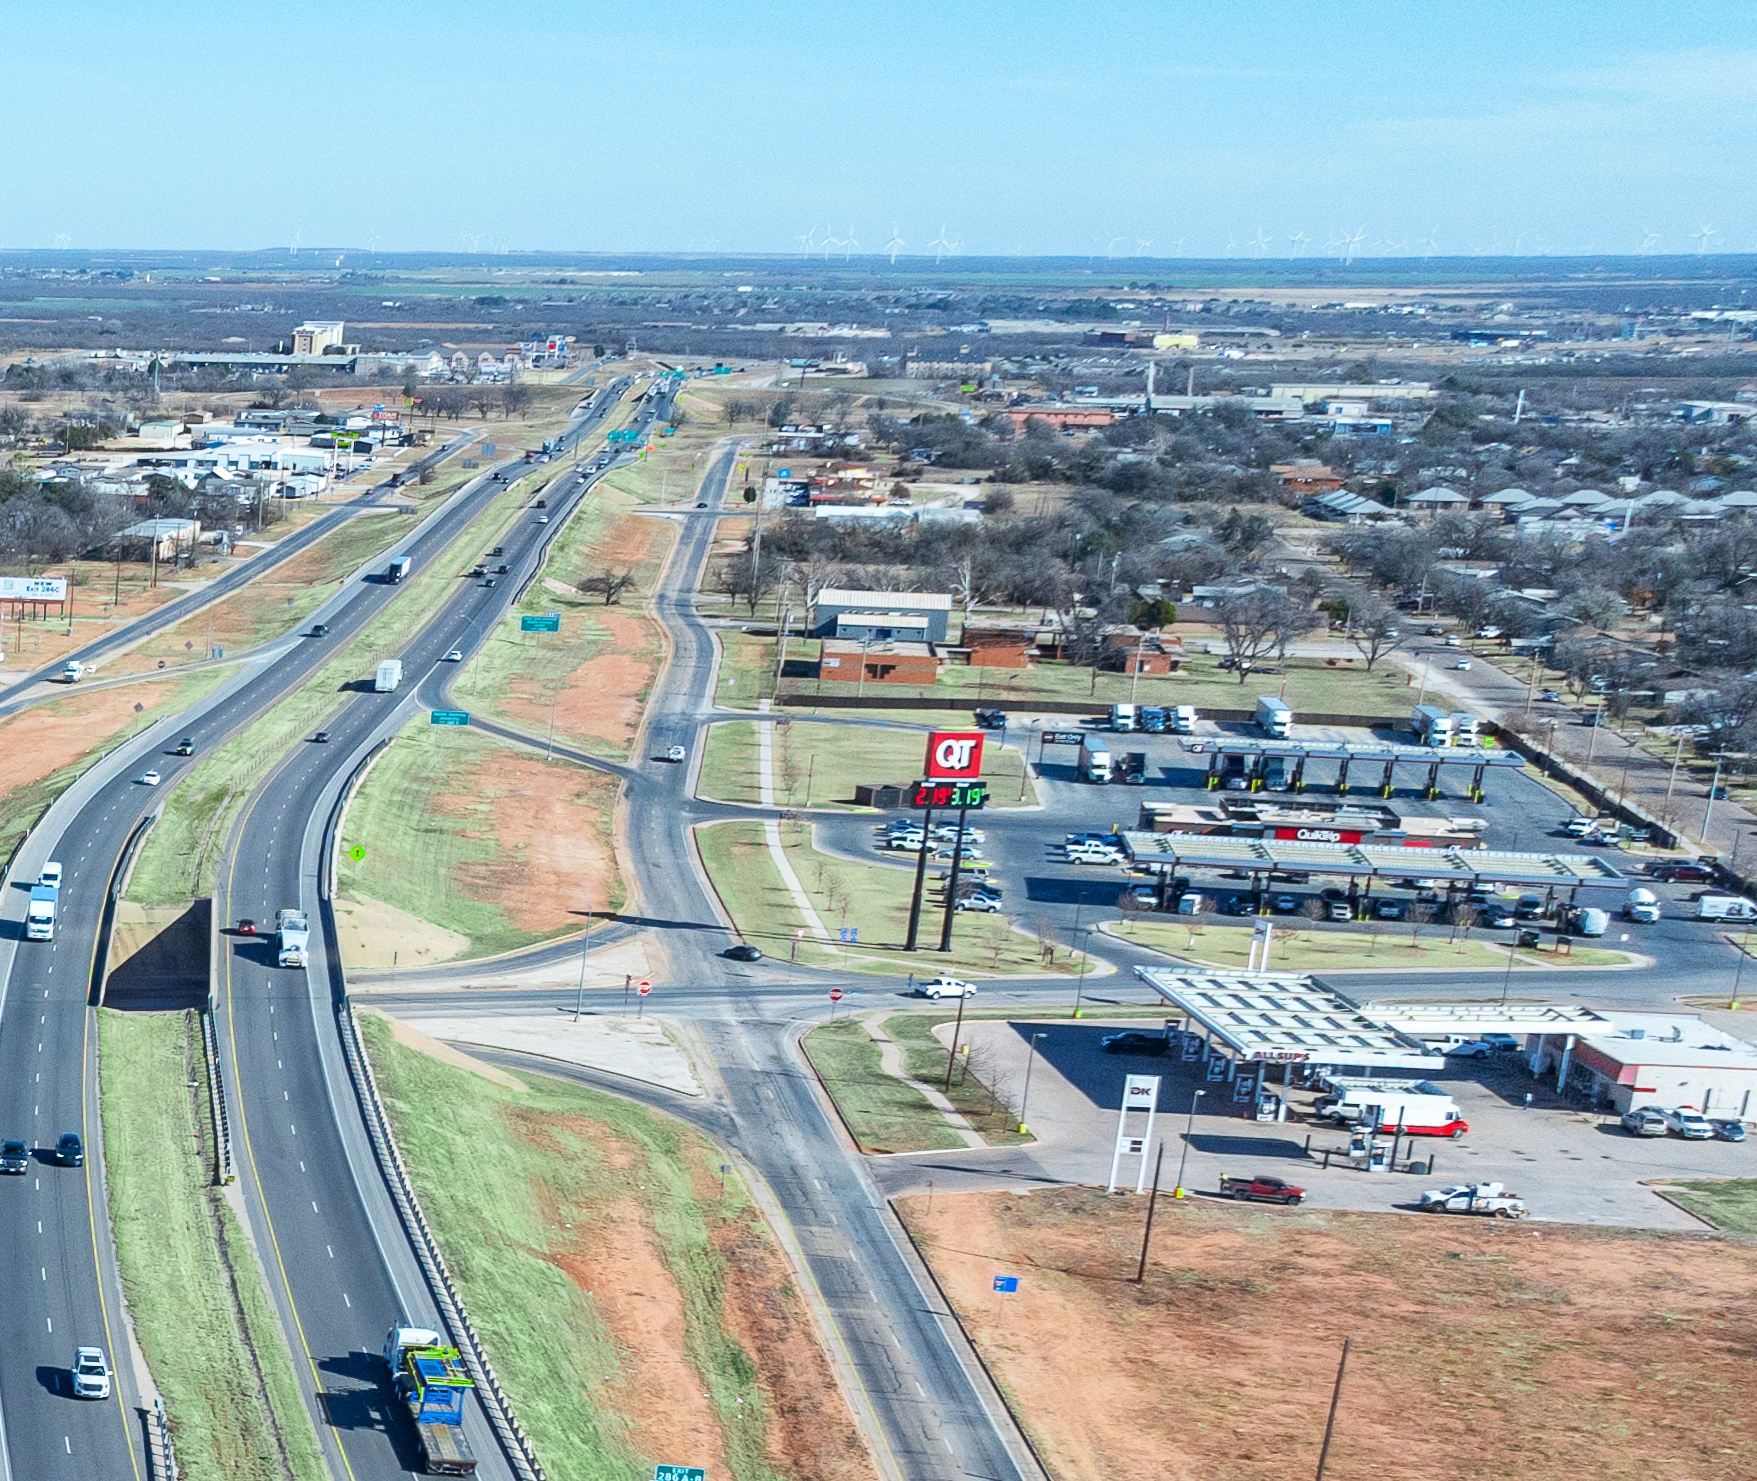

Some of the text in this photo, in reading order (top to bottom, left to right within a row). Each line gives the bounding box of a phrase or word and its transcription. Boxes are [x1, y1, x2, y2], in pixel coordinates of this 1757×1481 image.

[936, 739, 977, 770] QT
[1130, 1086, 1152, 1096] DK
[657, 1472, 679, 1481] 286
